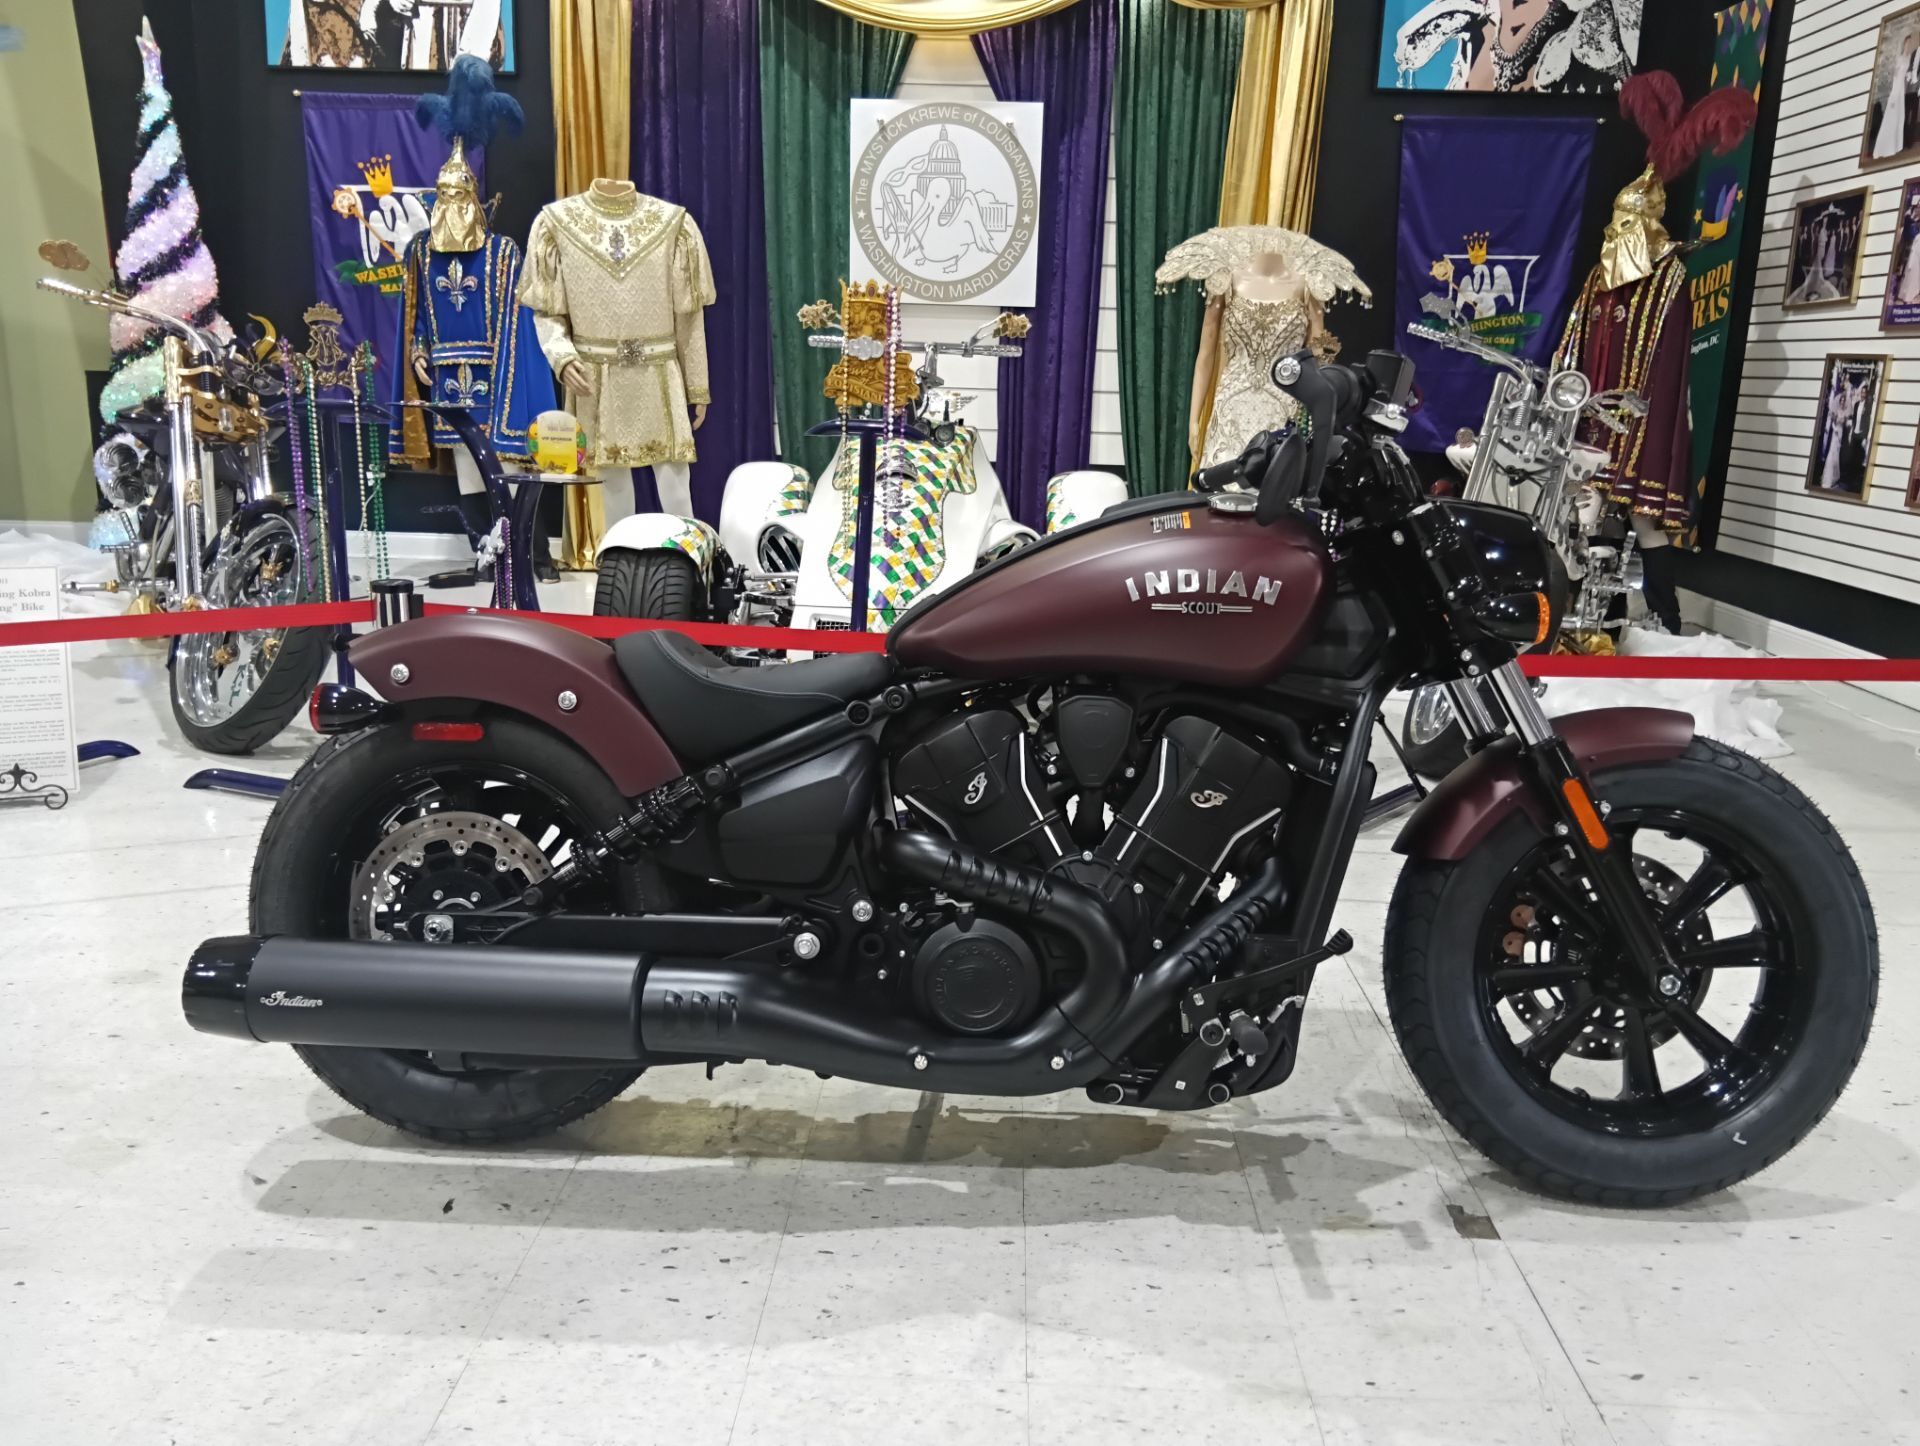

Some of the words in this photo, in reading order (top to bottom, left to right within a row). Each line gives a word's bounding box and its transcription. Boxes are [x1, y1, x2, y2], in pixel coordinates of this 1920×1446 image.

[856, 178, 869, 204] The
[863, 119, 909, 175] MYSTICK
[909, 106, 961, 126] KREWE
[964, 112, 978, 124] of
[979, 114, 1034, 209] LOUISIANIANS
[858, 224, 944, 298] WASHINGTON
[949, 271, 999, 298] MARDI
[999, 229, 1029, 271] GRAS
[1692, 286, 1730, 330] RAS
[1471, 315, 1524, 332] HINGTON
[19, 588, 51, 598] Kobra
[1125, 568, 1283, 606] INDIAN
[21, 602, 44, 611] Bike
[1181, 602, 1223, 615] SCOUT
[264, 991, 318, 1008] Indian
